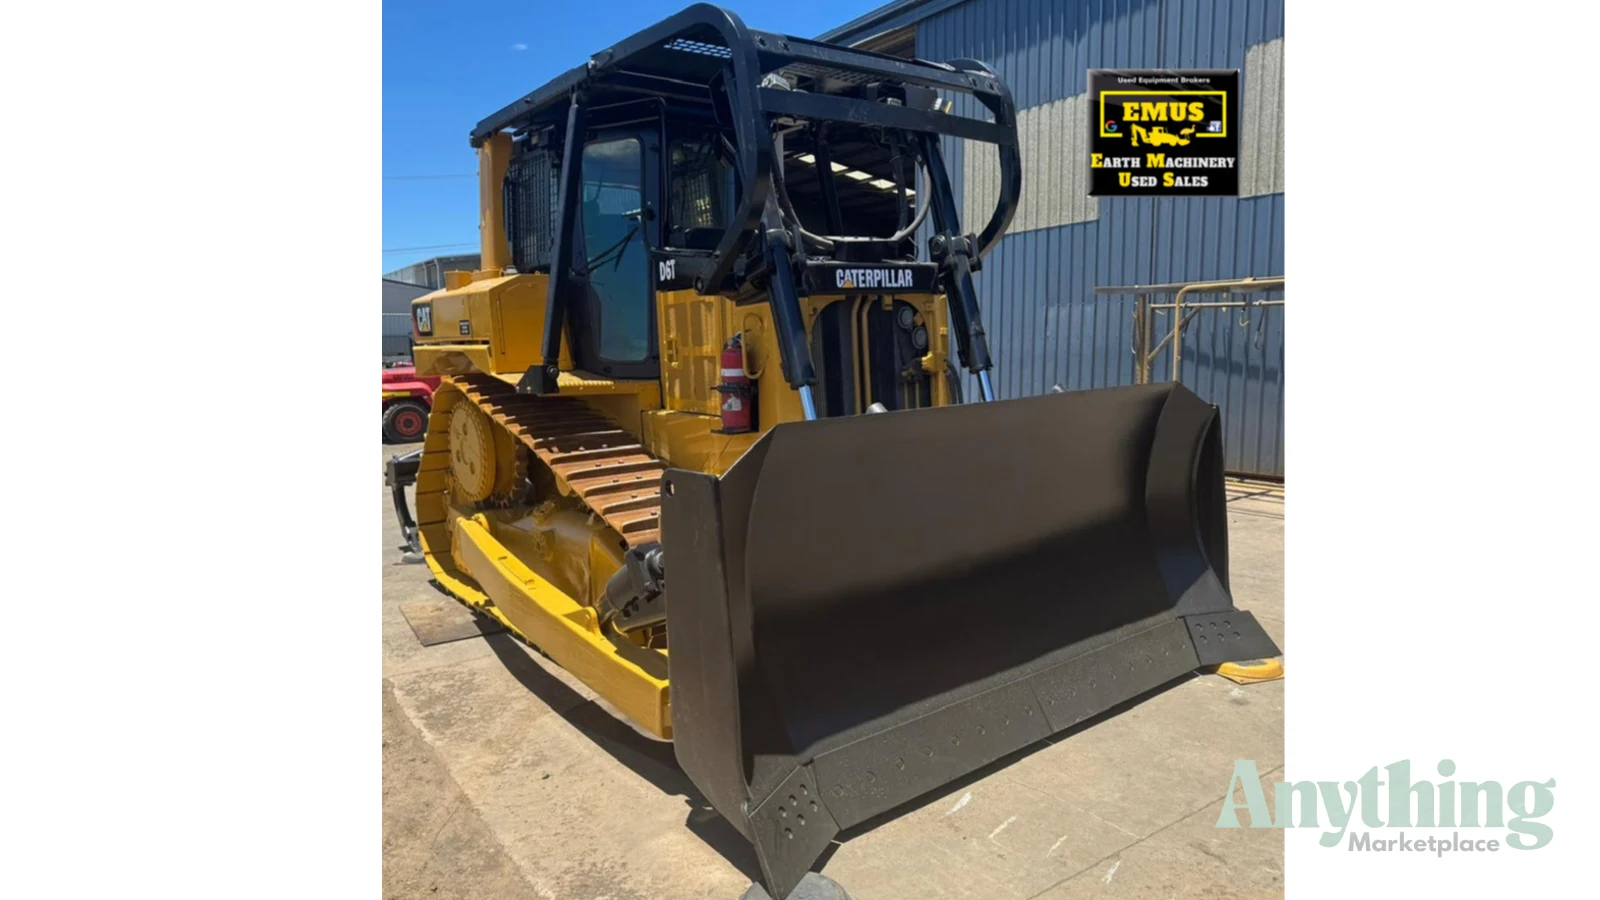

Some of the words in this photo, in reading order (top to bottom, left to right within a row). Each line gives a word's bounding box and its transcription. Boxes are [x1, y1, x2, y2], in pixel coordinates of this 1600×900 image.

[659, 259, 676, 281] D6T
[835, 268, 913, 288] CATERPILLAR
[416, 306, 432, 332] CAT
